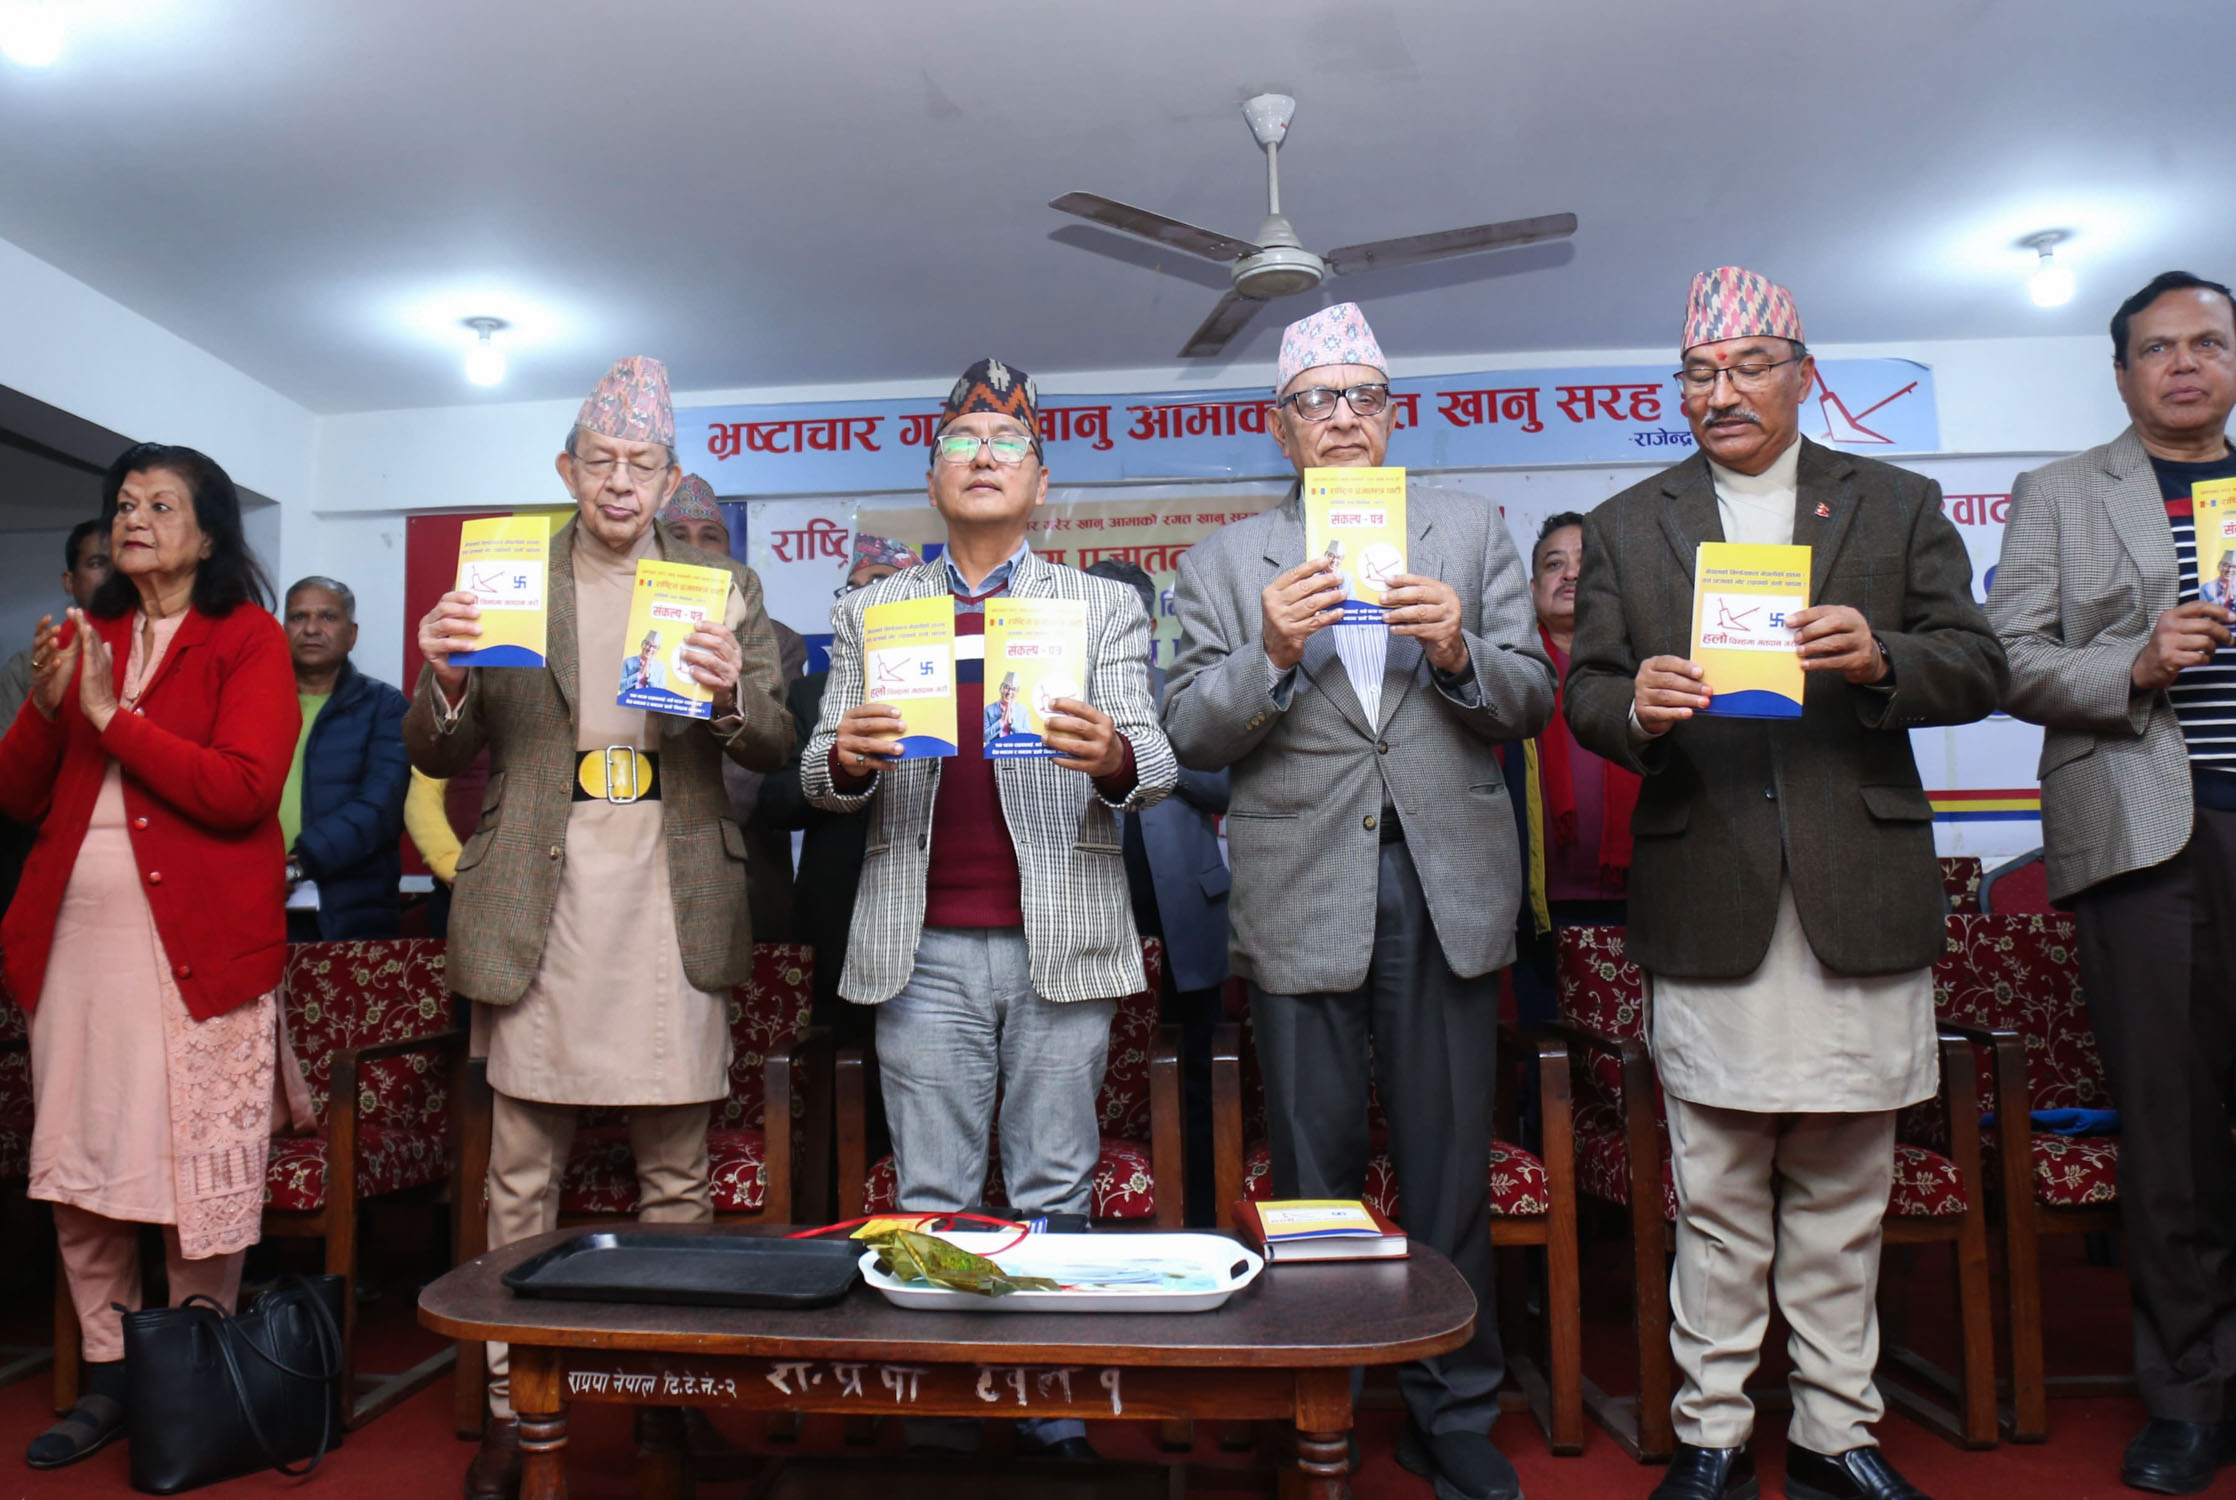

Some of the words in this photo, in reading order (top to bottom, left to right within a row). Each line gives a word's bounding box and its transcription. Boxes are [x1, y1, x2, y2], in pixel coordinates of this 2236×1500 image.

[708, 416, 884, 461] भ्रष्टाचार
[1126, 400, 1277, 440] आमाक
[1436, 387, 1545, 433] खानु
[1555, 383, 1663, 423] सरह
[568, 1371, 610, 1394] राप्रपा
[612, 1368, 657, 1397] नेपाल
